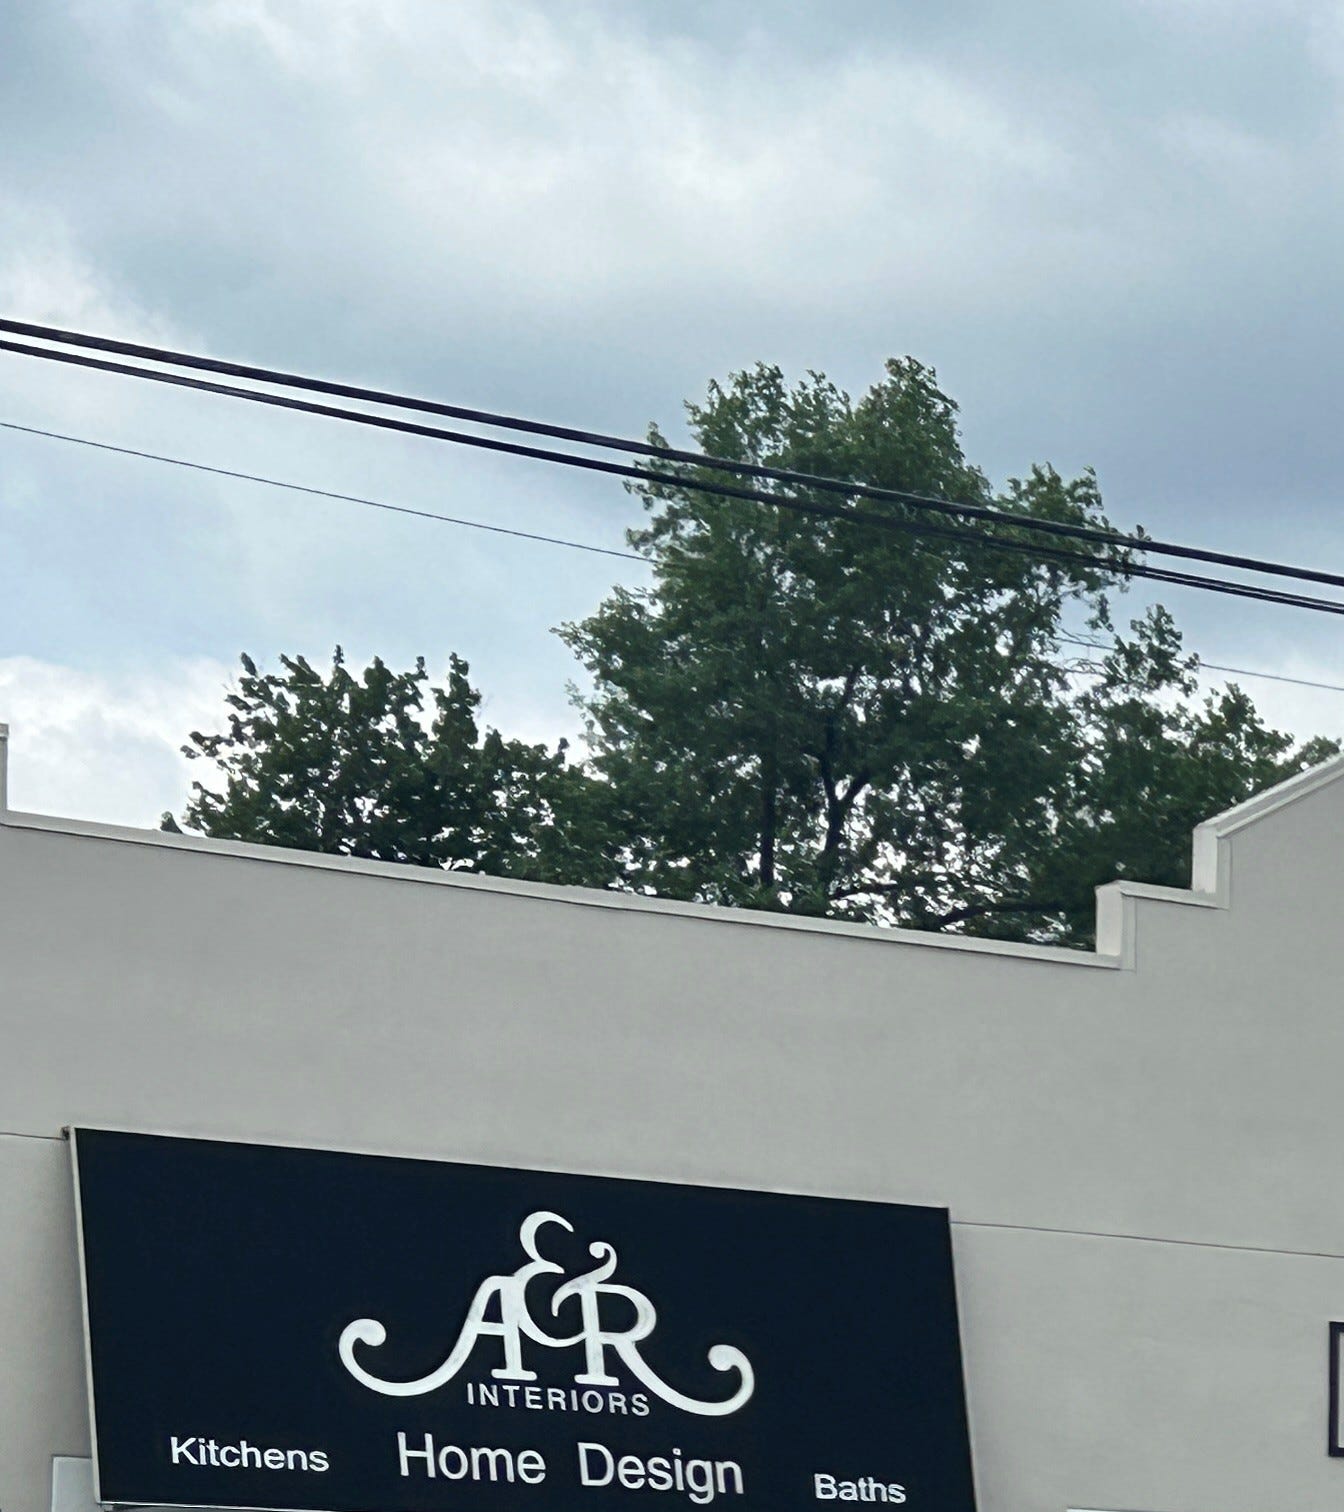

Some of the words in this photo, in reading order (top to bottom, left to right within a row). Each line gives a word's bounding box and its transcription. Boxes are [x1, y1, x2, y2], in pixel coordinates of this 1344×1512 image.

[466, 1382, 651, 1416] INTERIORS
[169, 1434, 330, 1473] Kitchens
[398, 1431, 547, 1486] Home
[577, 1441, 745, 1505] Design
[813, 1473, 907, 1505] Baths
